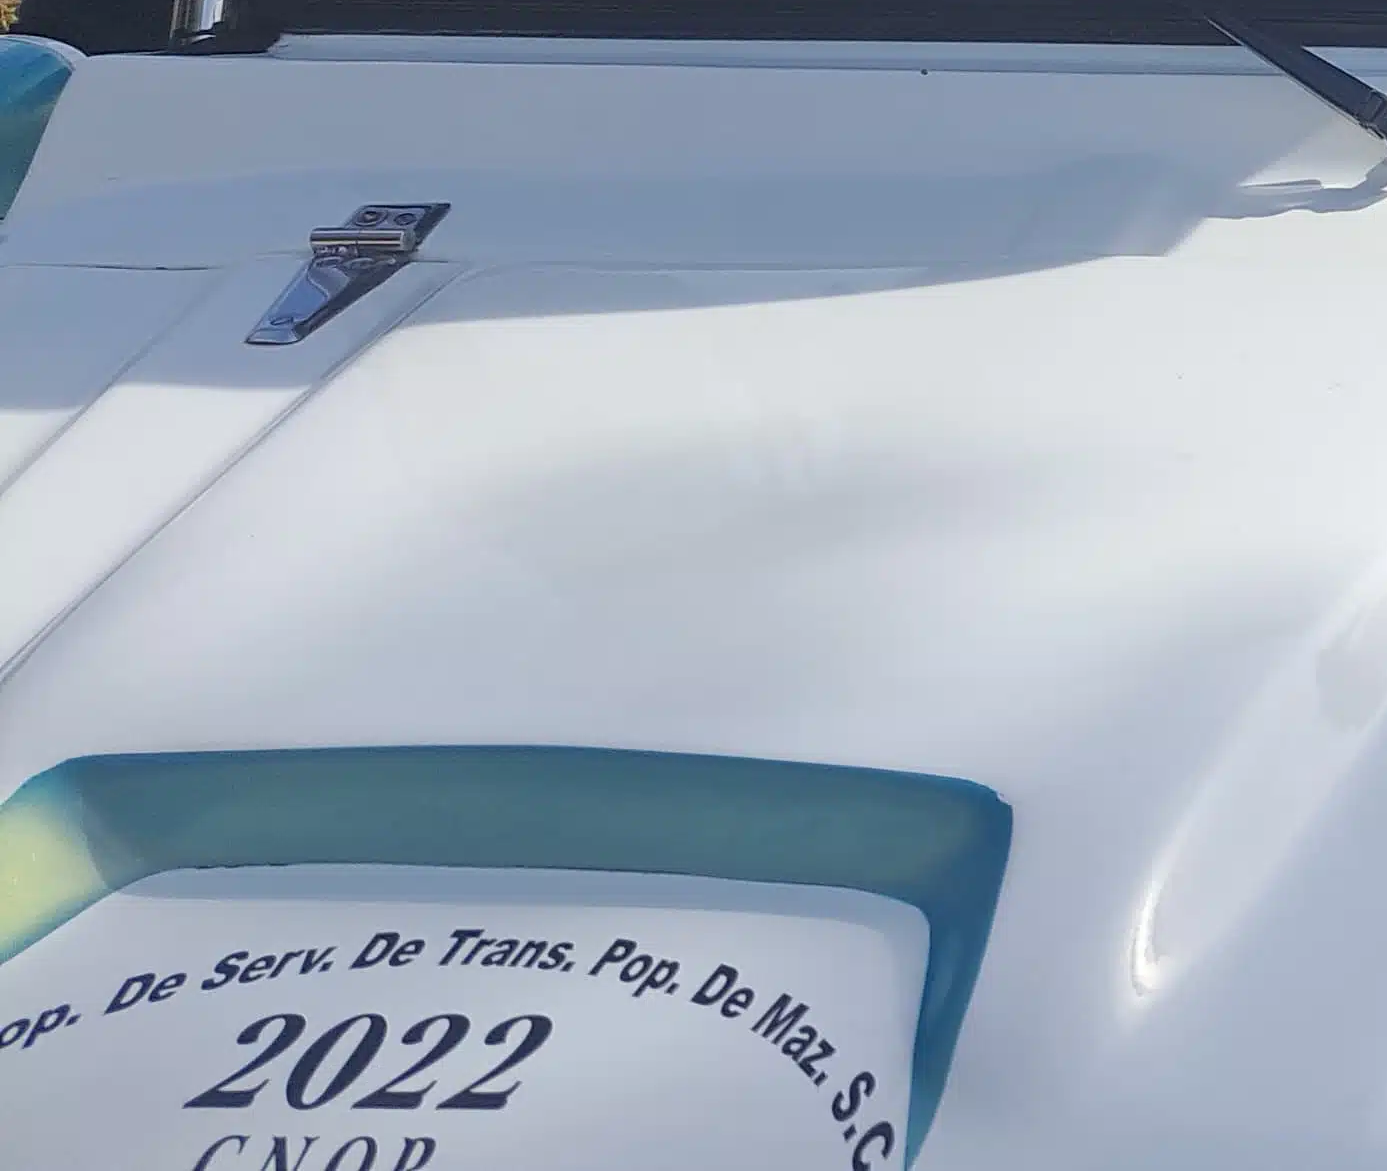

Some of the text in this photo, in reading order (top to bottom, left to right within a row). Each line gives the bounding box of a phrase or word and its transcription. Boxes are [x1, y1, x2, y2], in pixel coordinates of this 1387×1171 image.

[103, 972, 188, 1015] De
[200, 945, 338, 991] Serv.
[348, 931, 426, 970] De
[438, 928, 575, 972] Trans.
[587, 937, 681, 998] Pop.
[690, 963, 755, 1019] De
[750, 992, 837, 1087] Maz.
[181, 1012, 554, 1111] 2022
